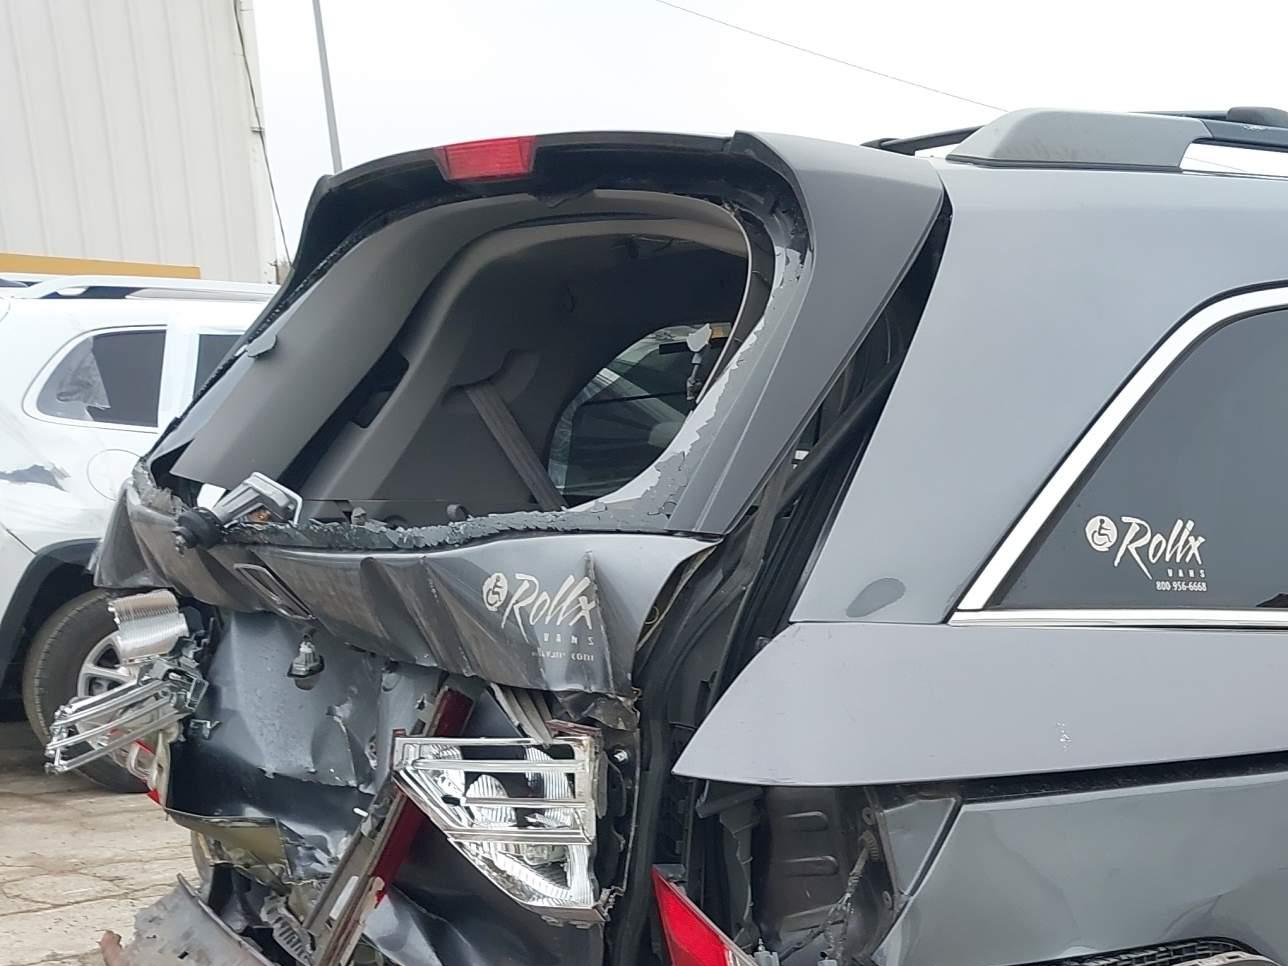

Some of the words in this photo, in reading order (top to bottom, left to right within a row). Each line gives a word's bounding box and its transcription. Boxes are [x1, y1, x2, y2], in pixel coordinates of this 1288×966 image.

[1113, 516, 1206, 580] Rollx
[1155, 581, 1171, 591] 800
[1167, 568, 1205, 578] VANS
[501, 573, 596, 644] Rollx
